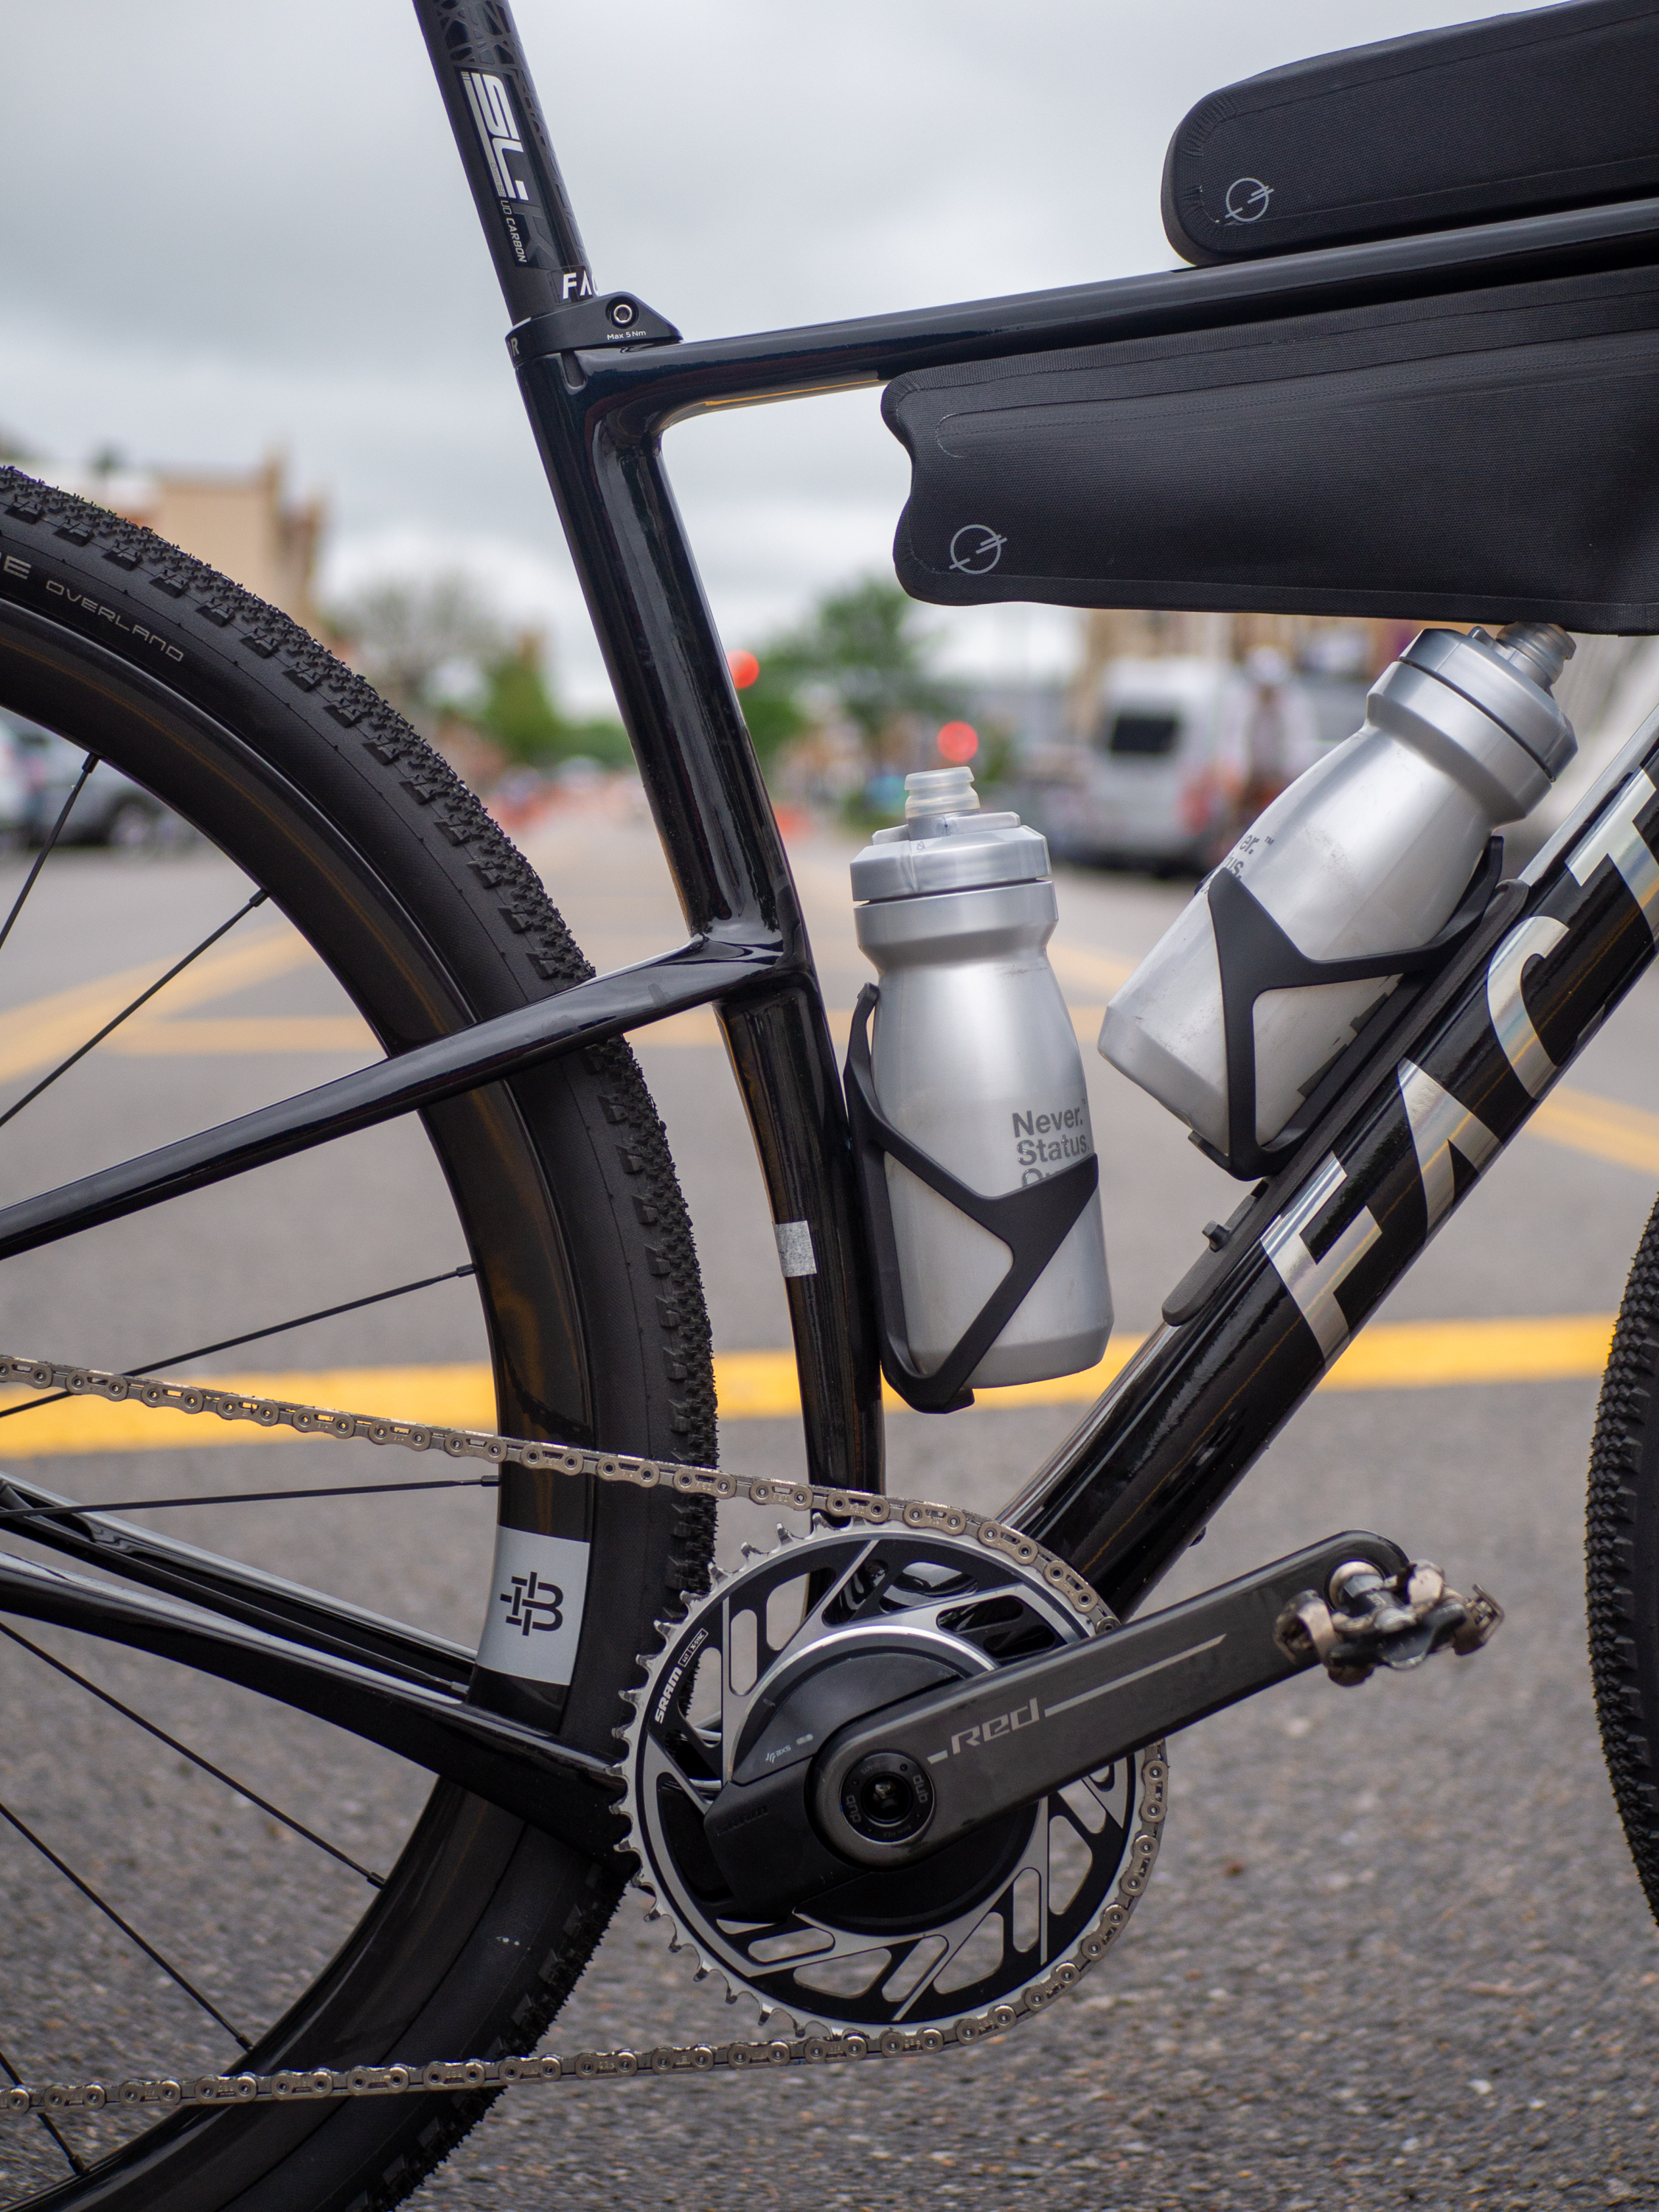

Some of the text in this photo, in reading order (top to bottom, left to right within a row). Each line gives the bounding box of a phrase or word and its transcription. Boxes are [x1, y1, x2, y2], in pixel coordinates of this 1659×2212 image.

[500, 200, 512, 215] UD
[506, 218, 527, 263] CARBON
[46, 580, 184, 662] OVERLAND
[1012, 1107, 1083, 1138] Never.
[1017, 1134, 1091, 1166] Status.
[654, 1666, 683, 1724] SRAM
